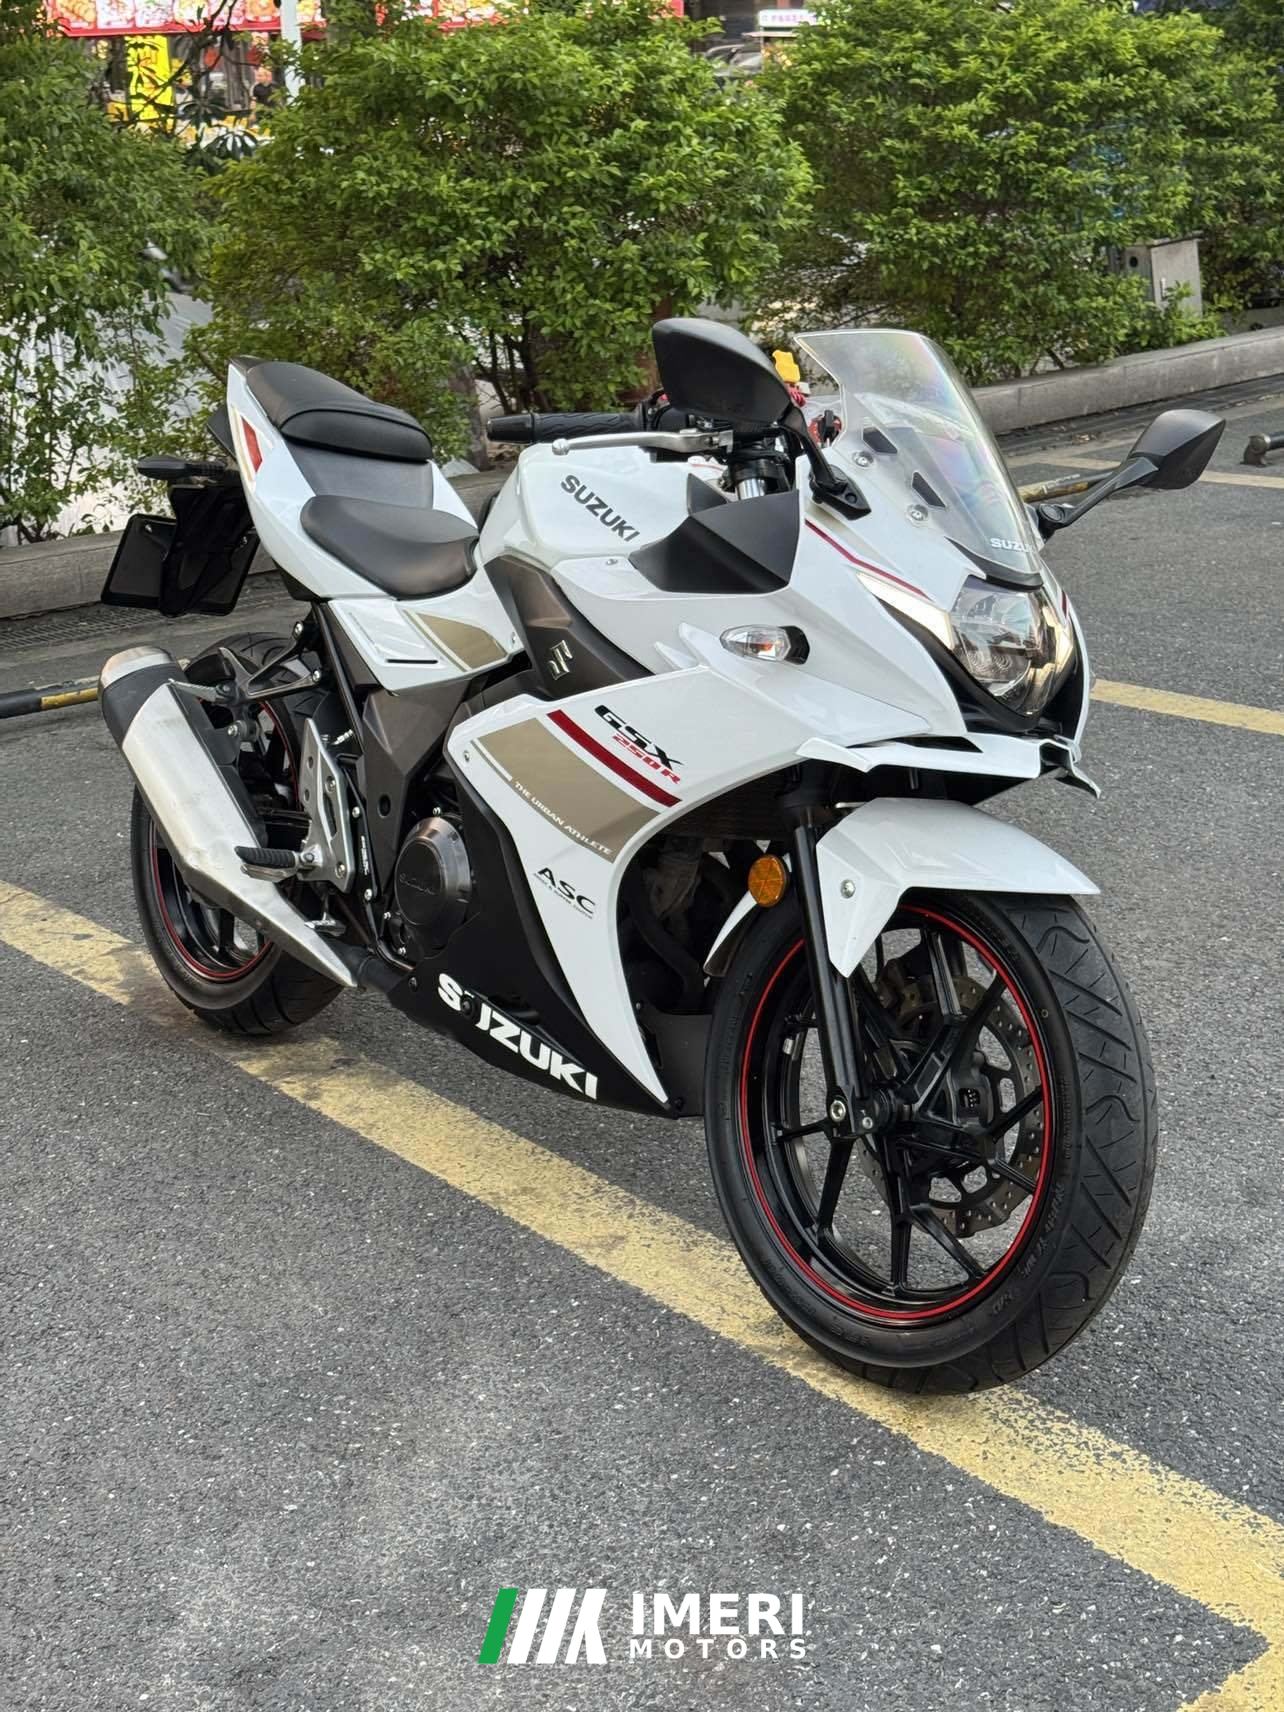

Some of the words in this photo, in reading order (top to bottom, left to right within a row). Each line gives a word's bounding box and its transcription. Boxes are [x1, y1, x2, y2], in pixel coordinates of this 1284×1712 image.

[560, 474, 641, 542] SUZUKI
[594, 704, 684, 771] GSX
[612, 732, 681, 784] 250R
[514, 780, 532, 799] THE
[531, 797, 565, 826] URBAN
[563, 824, 613, 856] ATHLETE
[537, 867, 596, 914] ASC
